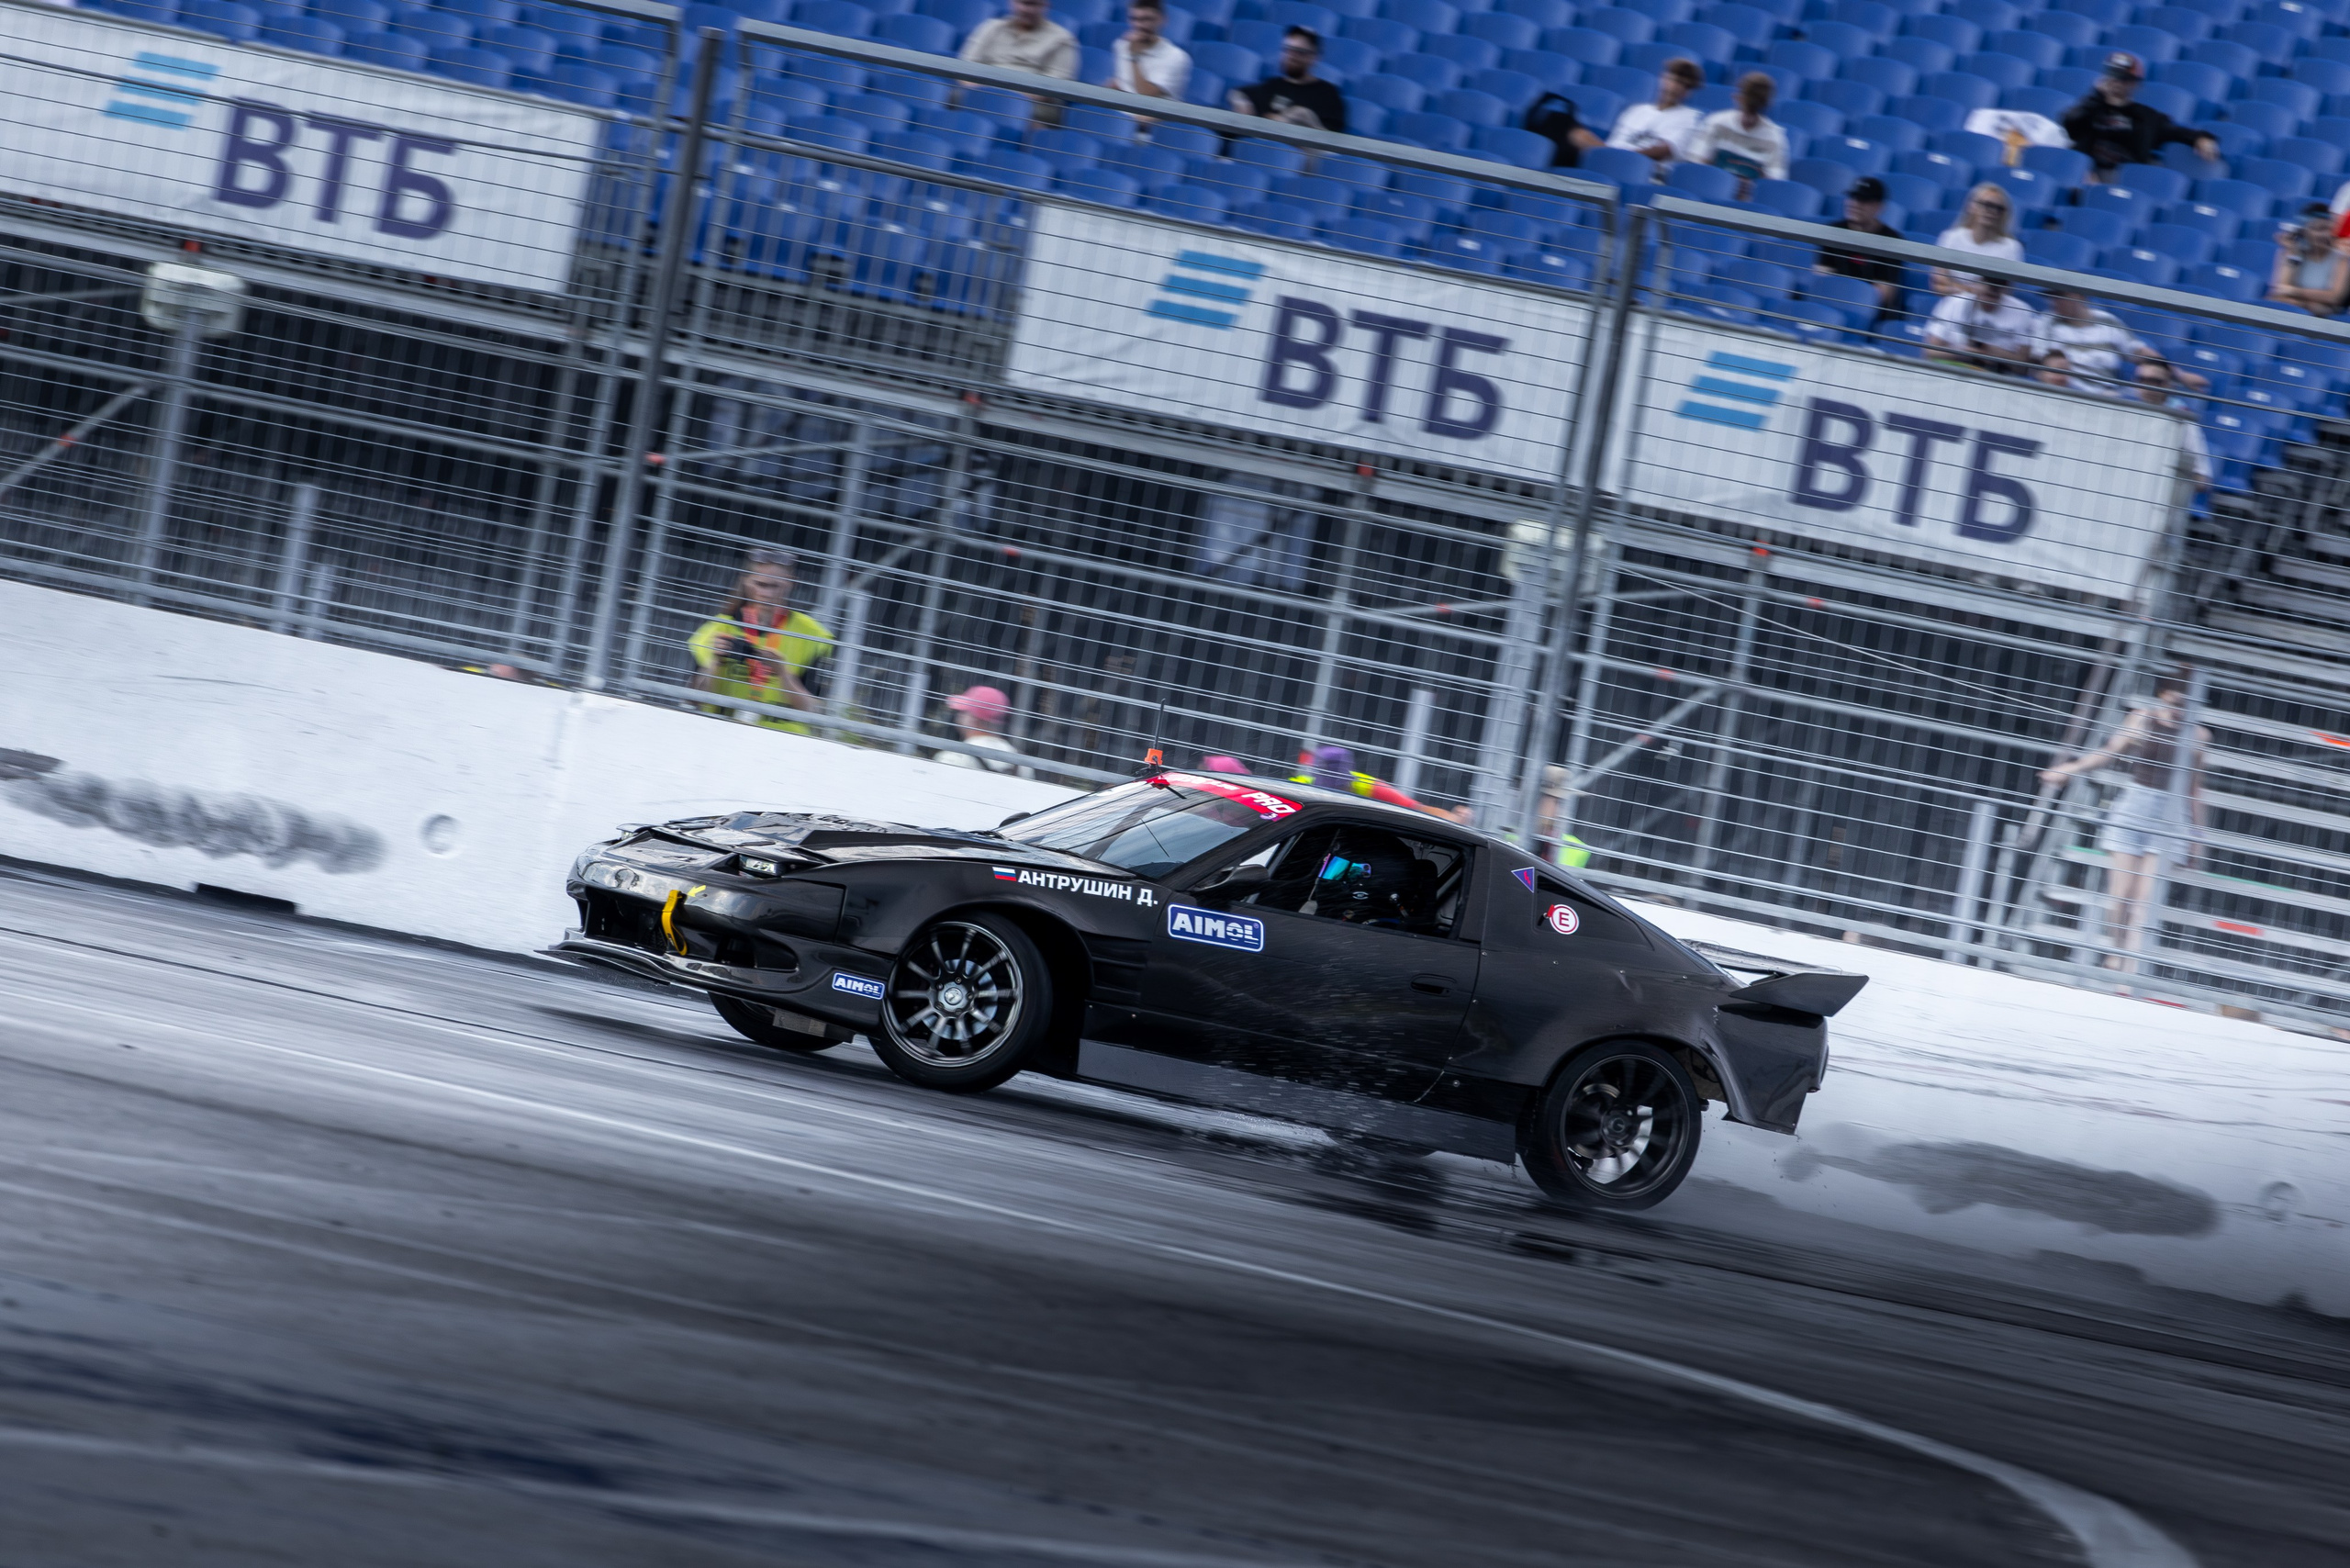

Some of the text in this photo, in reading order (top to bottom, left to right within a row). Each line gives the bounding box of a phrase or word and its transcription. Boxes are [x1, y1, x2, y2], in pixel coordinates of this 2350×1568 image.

[211, 95, 460, 241] ВТБ
[1256, 294, 1515, 442] ВТБ
[1788, 397, 2046, 544] ВТБ
[1241, 791, 1297, 814] PRO
[1017, 869, 1158, 907] АНТРУШИН Д.
[1559, 912, 1570, 927] E
